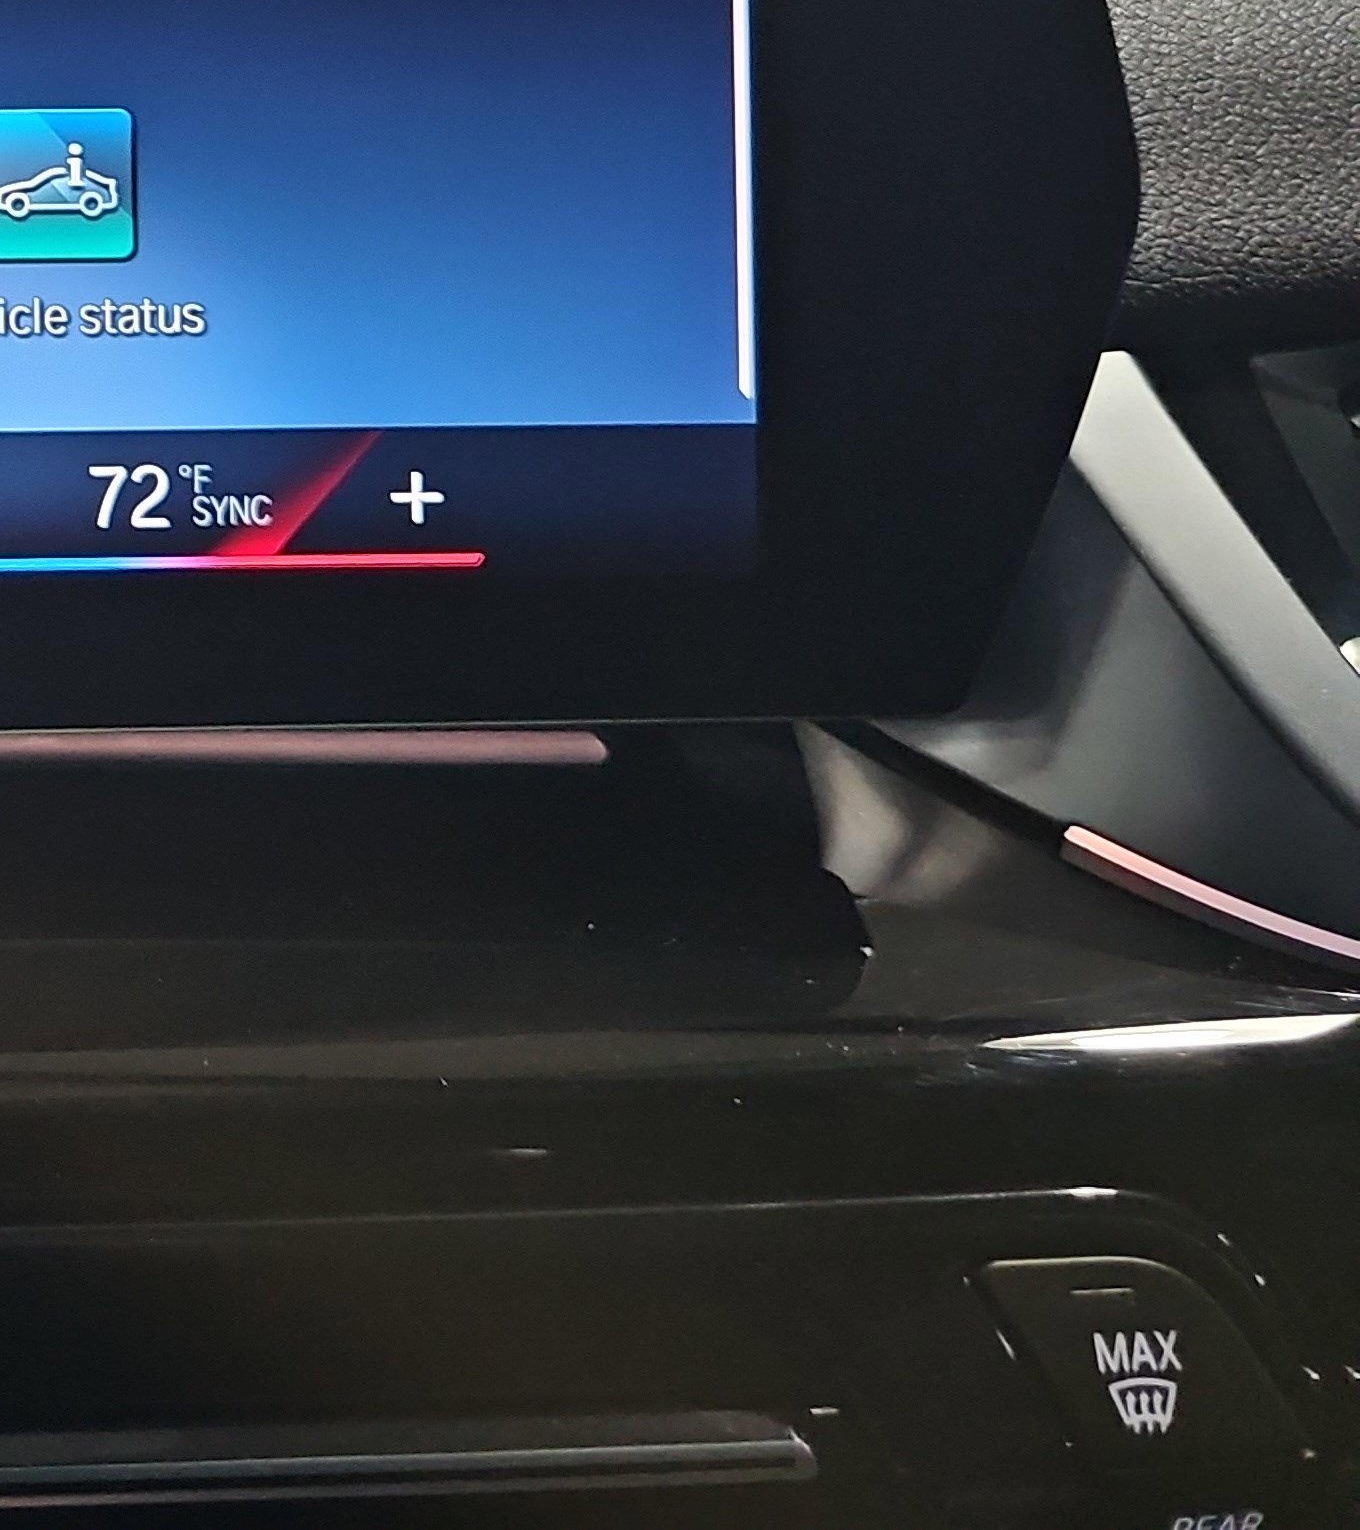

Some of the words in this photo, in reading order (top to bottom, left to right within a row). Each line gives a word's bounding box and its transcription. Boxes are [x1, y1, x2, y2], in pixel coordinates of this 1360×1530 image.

[79, 298, 205, 335] status
[88, 464, 171, 529] 72
[192, 494, 272, 527] SYNC
[1093, 1330, 1182, 1375] MAX
